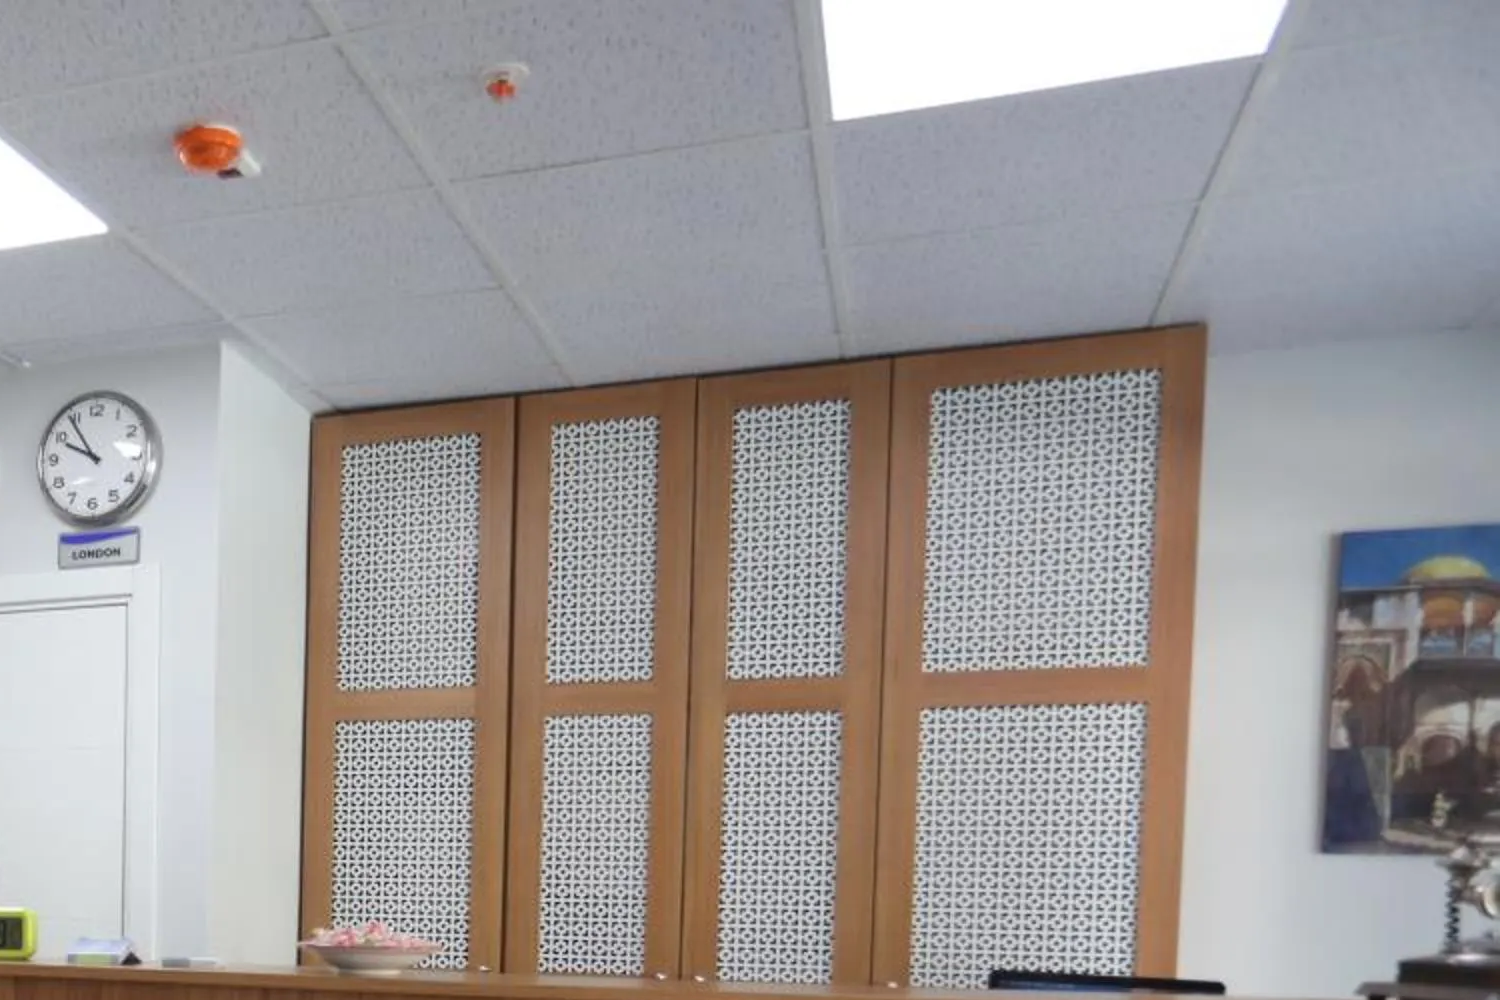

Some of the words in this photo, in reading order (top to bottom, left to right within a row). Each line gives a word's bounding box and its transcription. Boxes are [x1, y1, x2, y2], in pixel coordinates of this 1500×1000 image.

[89, 404, 105, 417] 12
[55, 431, 67, 444] 10
[125, 424, 138, 438] 2
[49, 454, 59, 467] 9
[52, 476, 65, 489] 8
[123, 472, 134, 484] 4
[67, 491, 77, 505] 7
[108, 489, 120, 503] 5
[87, 497, 99, 510] 6
[71, 547, 121, 561] LONDON
